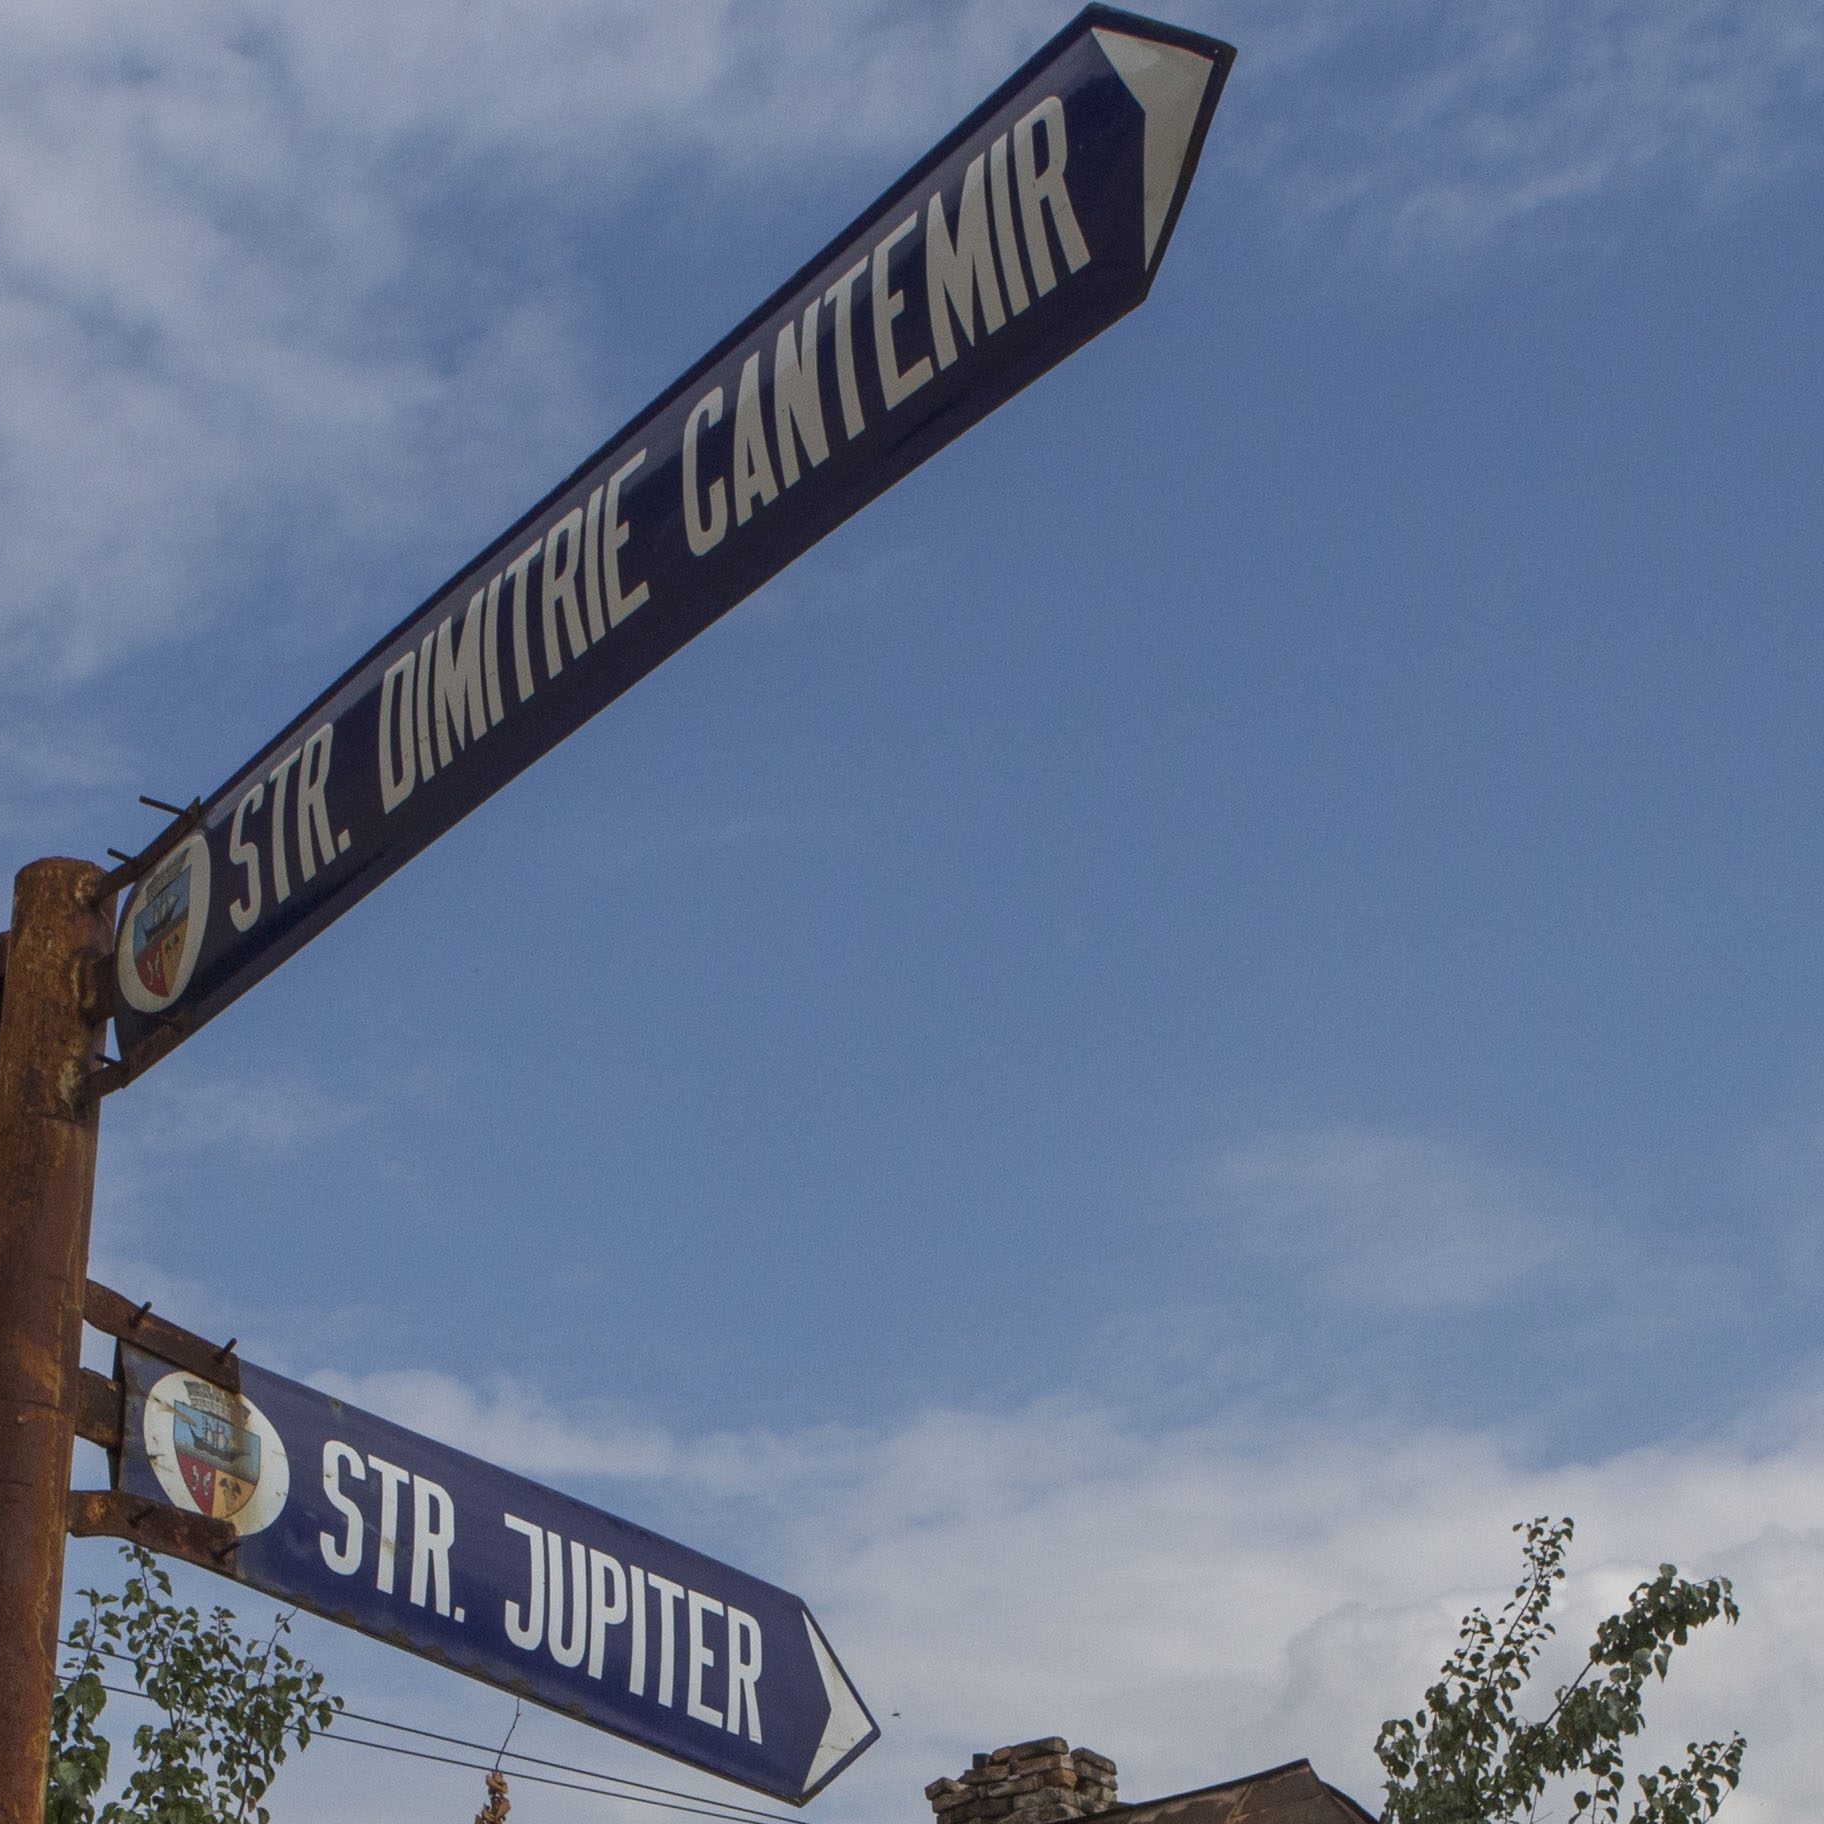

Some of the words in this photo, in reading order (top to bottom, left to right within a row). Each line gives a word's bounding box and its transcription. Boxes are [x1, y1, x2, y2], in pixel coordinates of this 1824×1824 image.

[228, 721, 352, 932] STR.
[378, 447, 651, 815] DIMITRIE
[681, 95, 1092, 557] CANTEMIR
[319, 1439, 466, 1623] STR.
[504, 1512, 764, 1746] JUPITER
